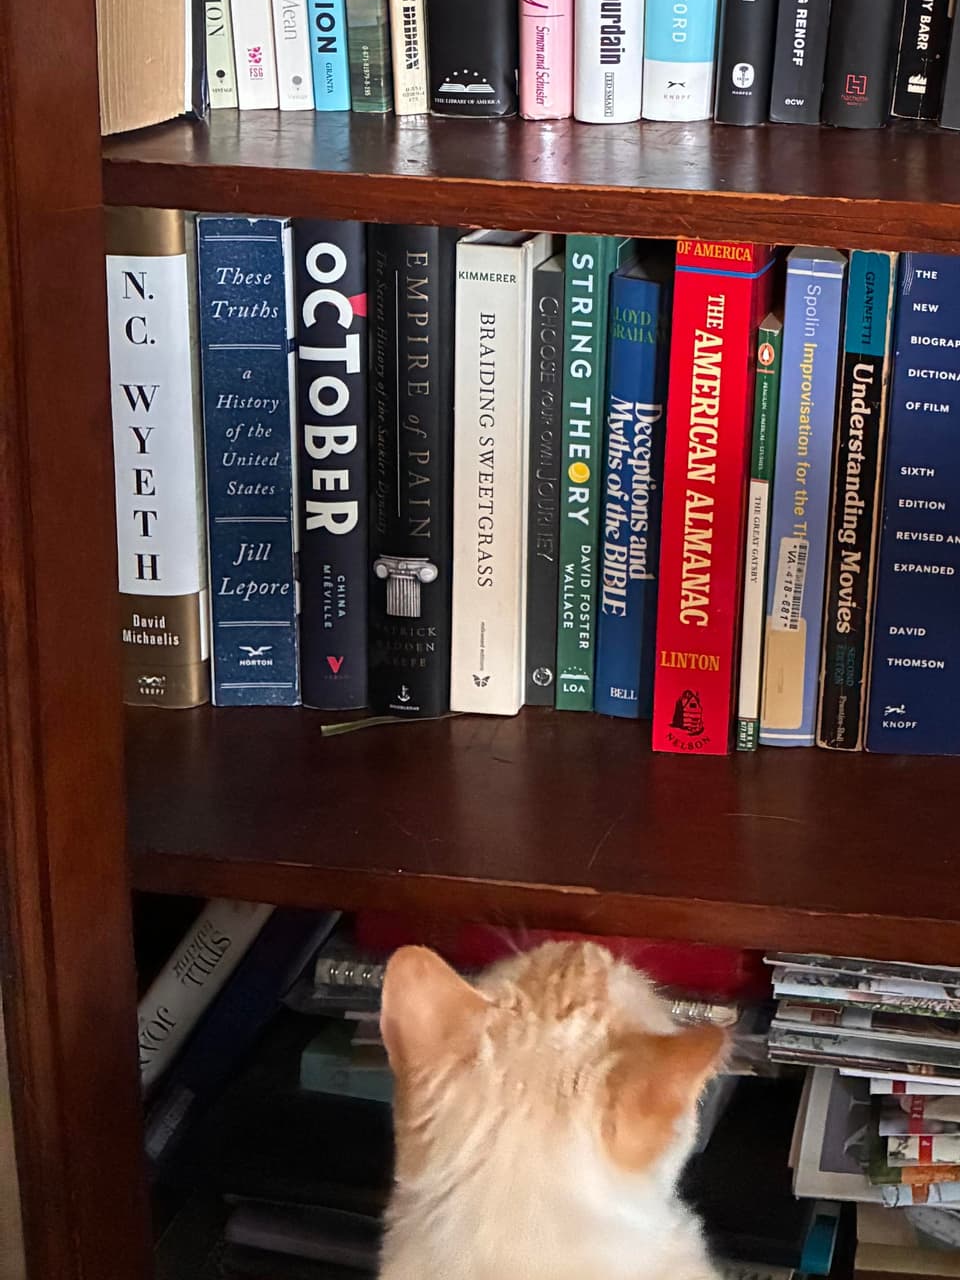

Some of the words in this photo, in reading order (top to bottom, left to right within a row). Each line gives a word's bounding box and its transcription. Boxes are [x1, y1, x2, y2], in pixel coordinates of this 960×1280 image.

[792, 9, 809, 66] RENOFF
[917, 15, 931, 50] BARR
[216, 267, 272, 285] These
[459, 271, 517, 283] KIMMERER
[915, 270, 938, 280] THE
[122, 271, 154, 300] N.
[211, 300, 278, 319] Truths
[569, 252, 594, 378] STRING
[706, 295, 725, 329] THE
[804, 284, 821, 337] Spolin
[913, 303, 939, 313] NEW
[125, 316, 156, 345] C.
[242, 369, 253, 379] a
[478, 311, 496, 428] BRAIDING
[299, 242, 361, 535] OCTOBER
[216, 395, 280, 412] History
[686, 330, 723, 484] AMERICAN
[796, 343, 818, 458] Improvisation
[906, 402, 921, 411] OF
[923, 402, 950, 413] FILM
[226, 424, 244, 442] of
[247, 424, 273, 438] the
[221, 452, 279, 467] United
[836, 363, 875, 546] Understanding
[901, 467, 935, 477] SIXTH
[119, 384, 161, 581] WYETH
[227, 481, 276, 496] States
[477, 436, 495, 588] SWEETGRASS
[898, 499, 946, 510] EDITION
[896, 531, 944, 542] REVISED
[233, 544, 272, 566] Jill
[679, 490, 715, 627] ALMANAC
[580, 545, 591, 588] DAVID
[894, 564, 955, 575] EXPANDED
[218, 578, 290, 601] Lepore
[563, 564, 574, 629] WALLACE
[836, 552, 861, 634] Movies
[132, 614, 166, 629] David
[579, 594, 590, 649] FOSTER
[122, 630, 180, 646] Michaelis
[889, 627, 926, 636] DAVID
[661, 651, 720, 671] LINTON
[887, 658, 945, 668] THOMSON
[563, 685, 585, 694] LOA
[610, 687, 637, 700] BELL
[883, 721, 917, 729] KNOPF
